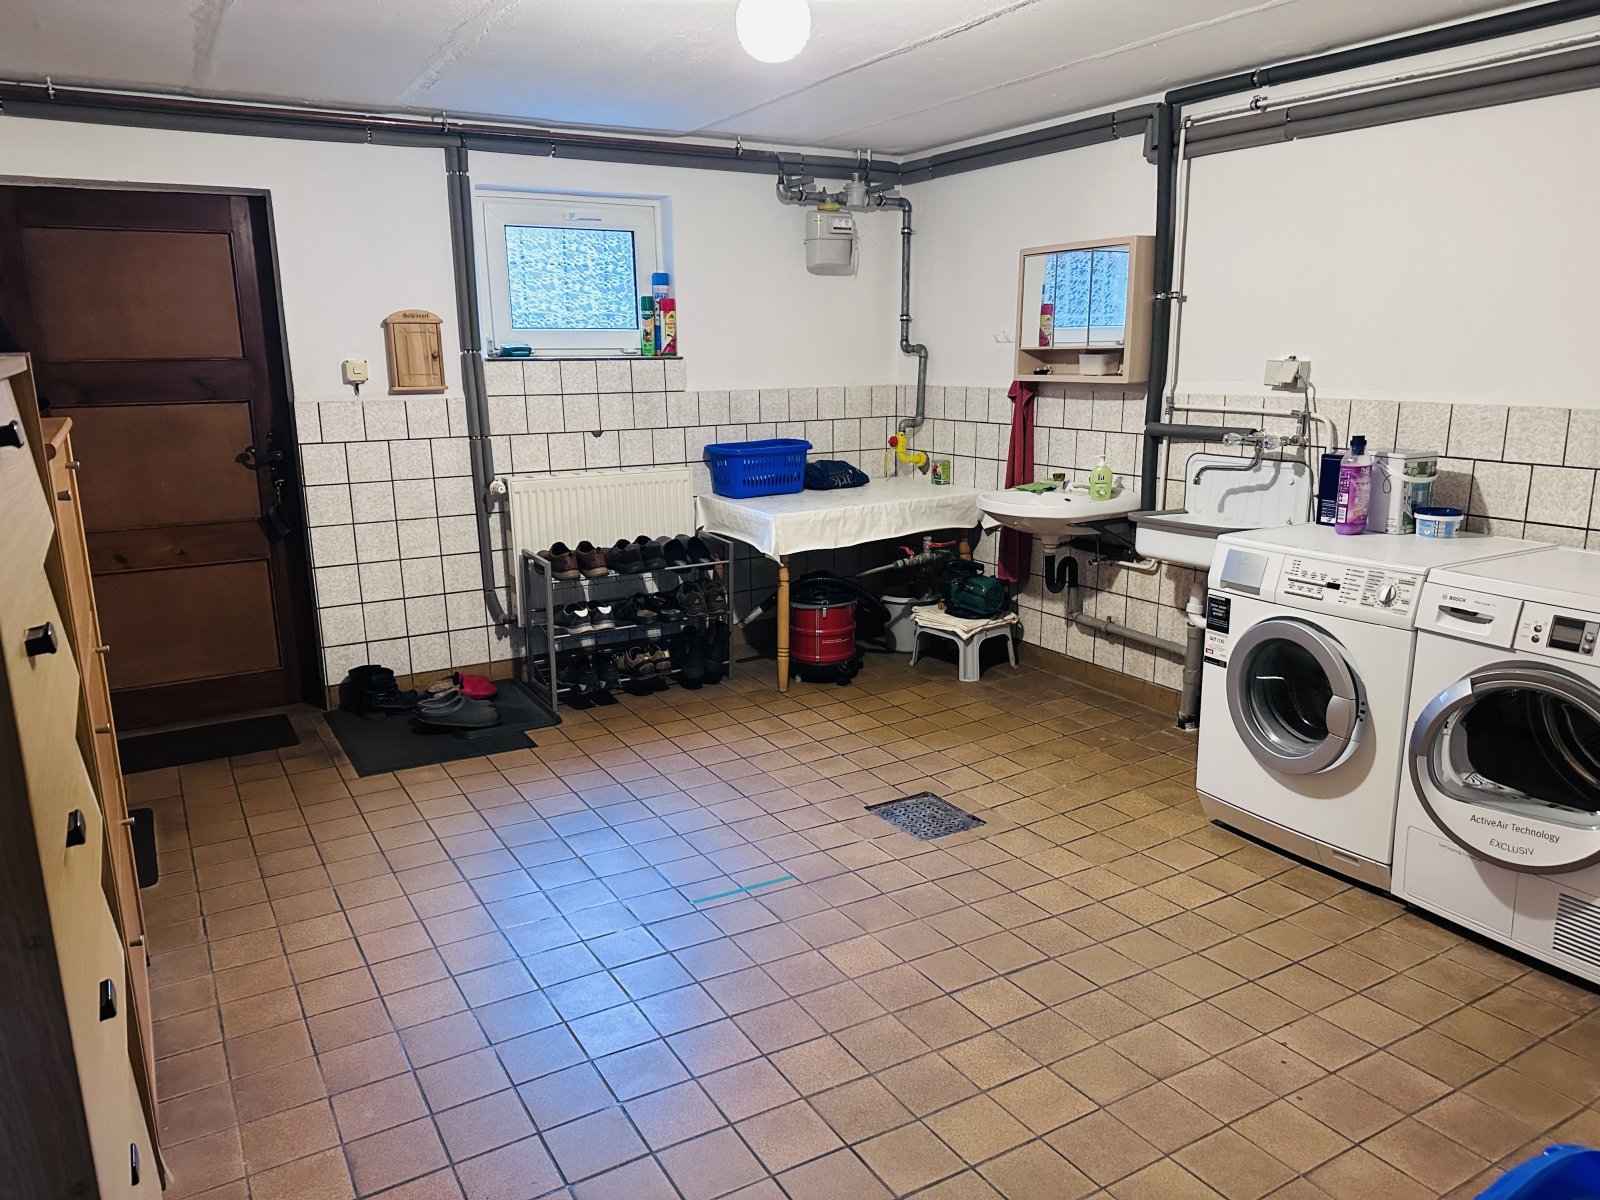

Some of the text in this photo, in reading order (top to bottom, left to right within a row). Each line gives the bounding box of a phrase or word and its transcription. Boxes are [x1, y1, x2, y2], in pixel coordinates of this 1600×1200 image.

[1449, 595, 1466, 603] BOSCH
[1470, 814, 1561, 844] ActiveAir Technology
[1489, 838, 1535, 856] EXCLUSIV
